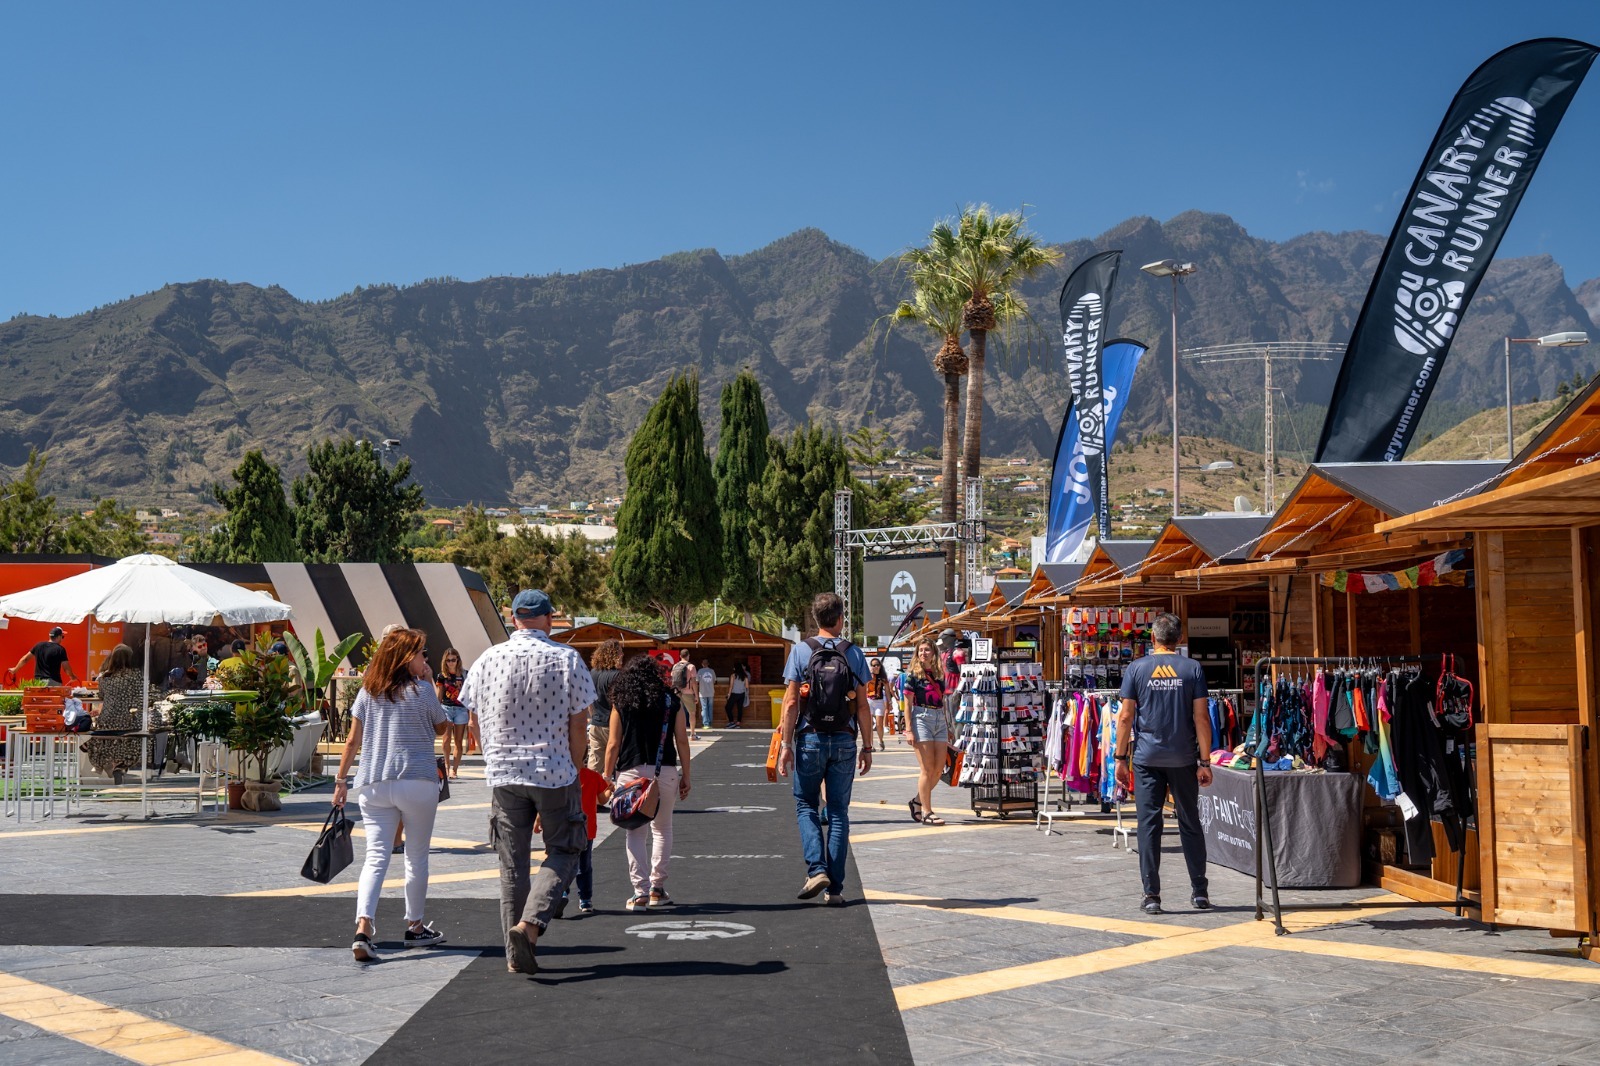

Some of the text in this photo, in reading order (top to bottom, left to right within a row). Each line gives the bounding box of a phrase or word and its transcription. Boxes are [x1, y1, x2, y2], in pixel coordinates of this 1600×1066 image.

[1405, 124, 1486, 267] CANARY
[1442, 145, 1528, 272] RUNNER
[1085, 317, 1102, 399] RUNNER
[1100, 452, 1108, 541] canaryrunnercom
[1147, 679, 1183, 687] AONIJIE
